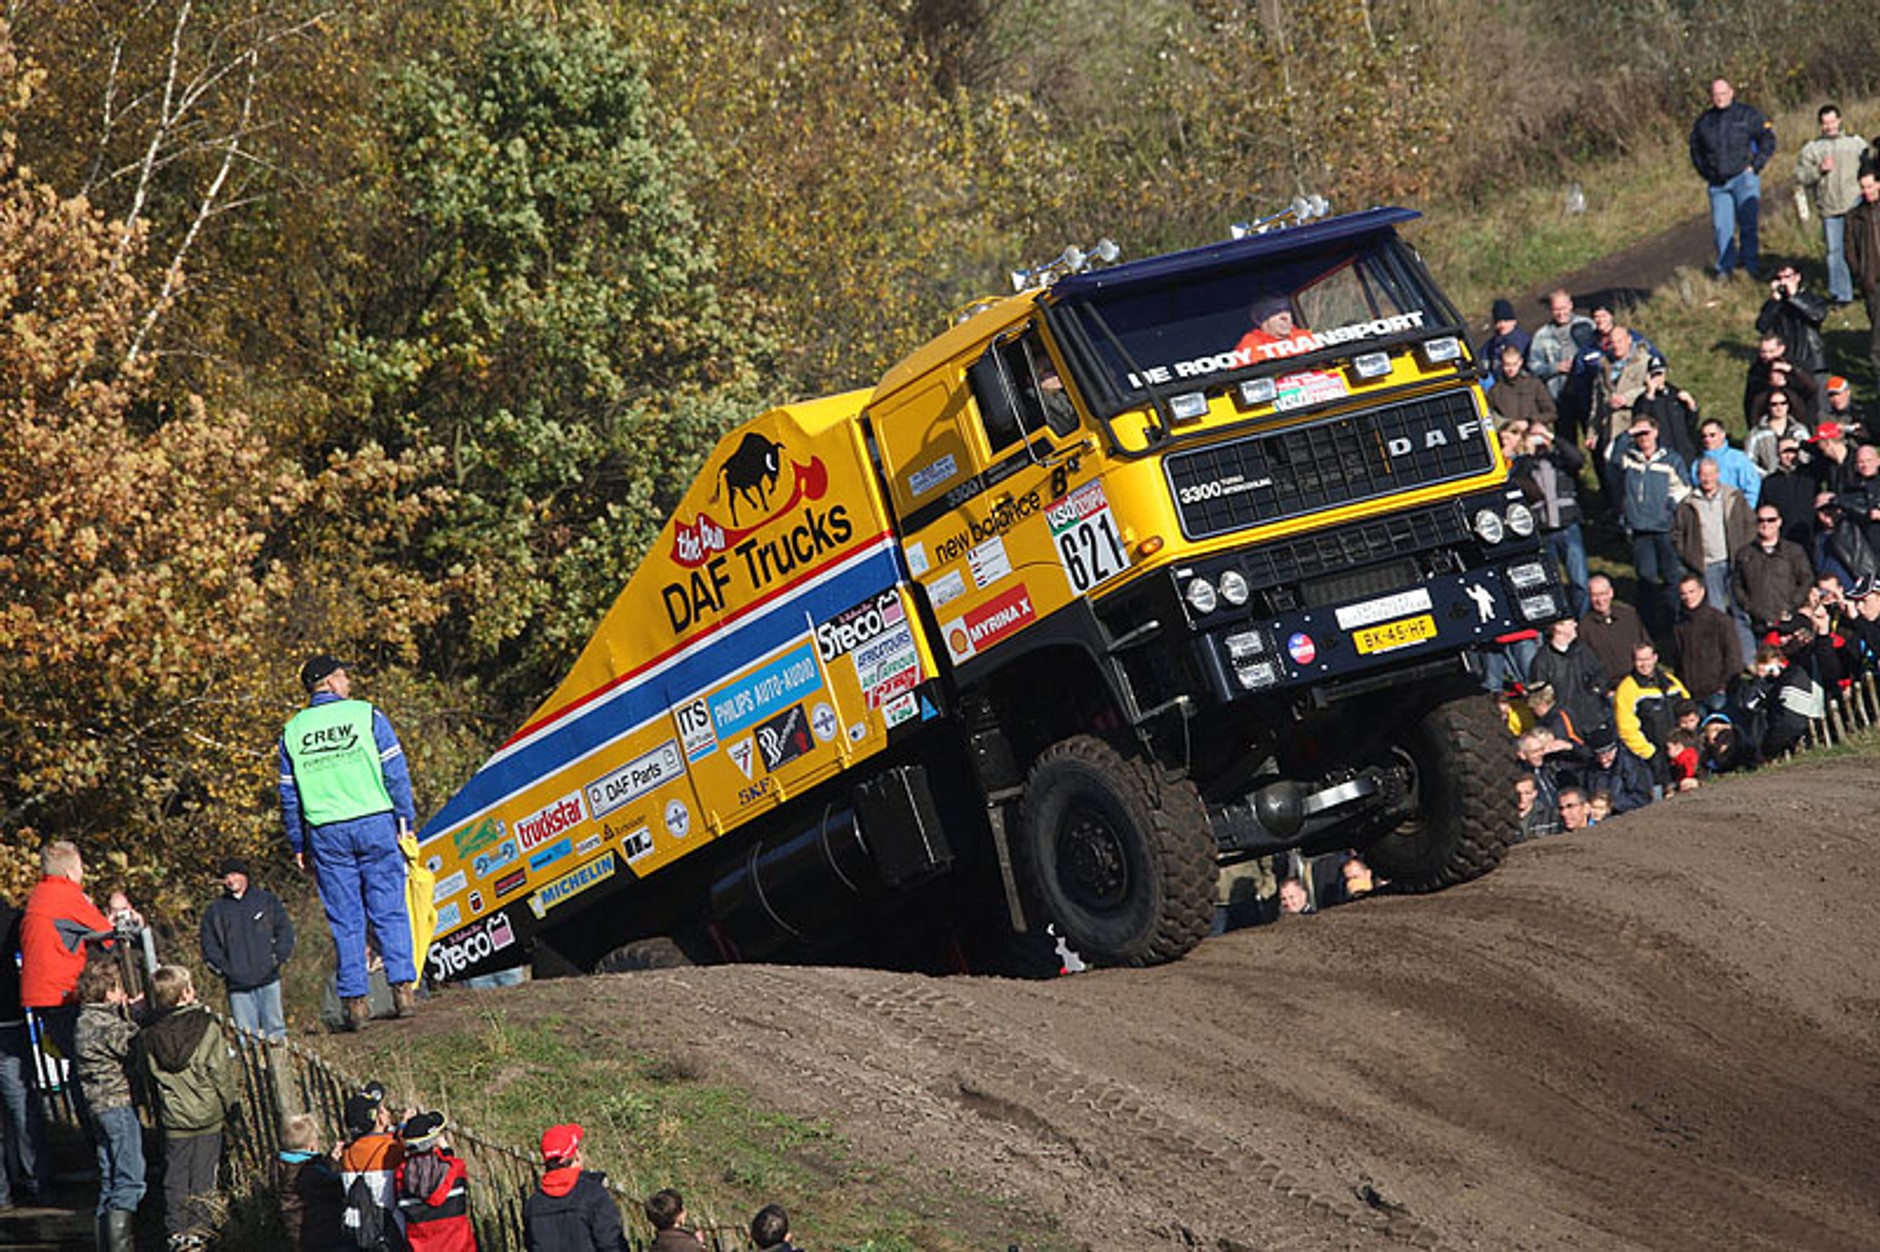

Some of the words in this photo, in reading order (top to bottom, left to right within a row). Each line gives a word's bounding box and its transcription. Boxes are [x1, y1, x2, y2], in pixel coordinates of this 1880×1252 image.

[1128, 365, 1172, 389] DE
[1174, 350, 1253, 379] ROOY
[1255, 311, 1425, 360] TRANSPORT
[1388, 420, 1481, 457] DAF
[1180, 481, 1221, 504] 3300
[935, 529, 970, 565] new
[968, 491, 1041, 542] balance
[1060, 513, 1125, 592] 621
[661, 555, 731, 634] DAF
[735, 505, 853, 589] Trucks
[818, 610, 881, 661] Steco
[969, 603, 1021, 643] MYRINA
[1019, 597, 1032, 616] X
[677, 702, 709, 736] ITS
[714, 691, 753, 727] PHILIPS
[302, 723, 353, 747] CREW
[606, 774, 630, 801] DAF
[631, 763, 662, 788] Parts
[517, 798, 582, 849] truckstar
[540, 855, 614, 905] MICHELIN
[428, 932, 491, 981] Steco
